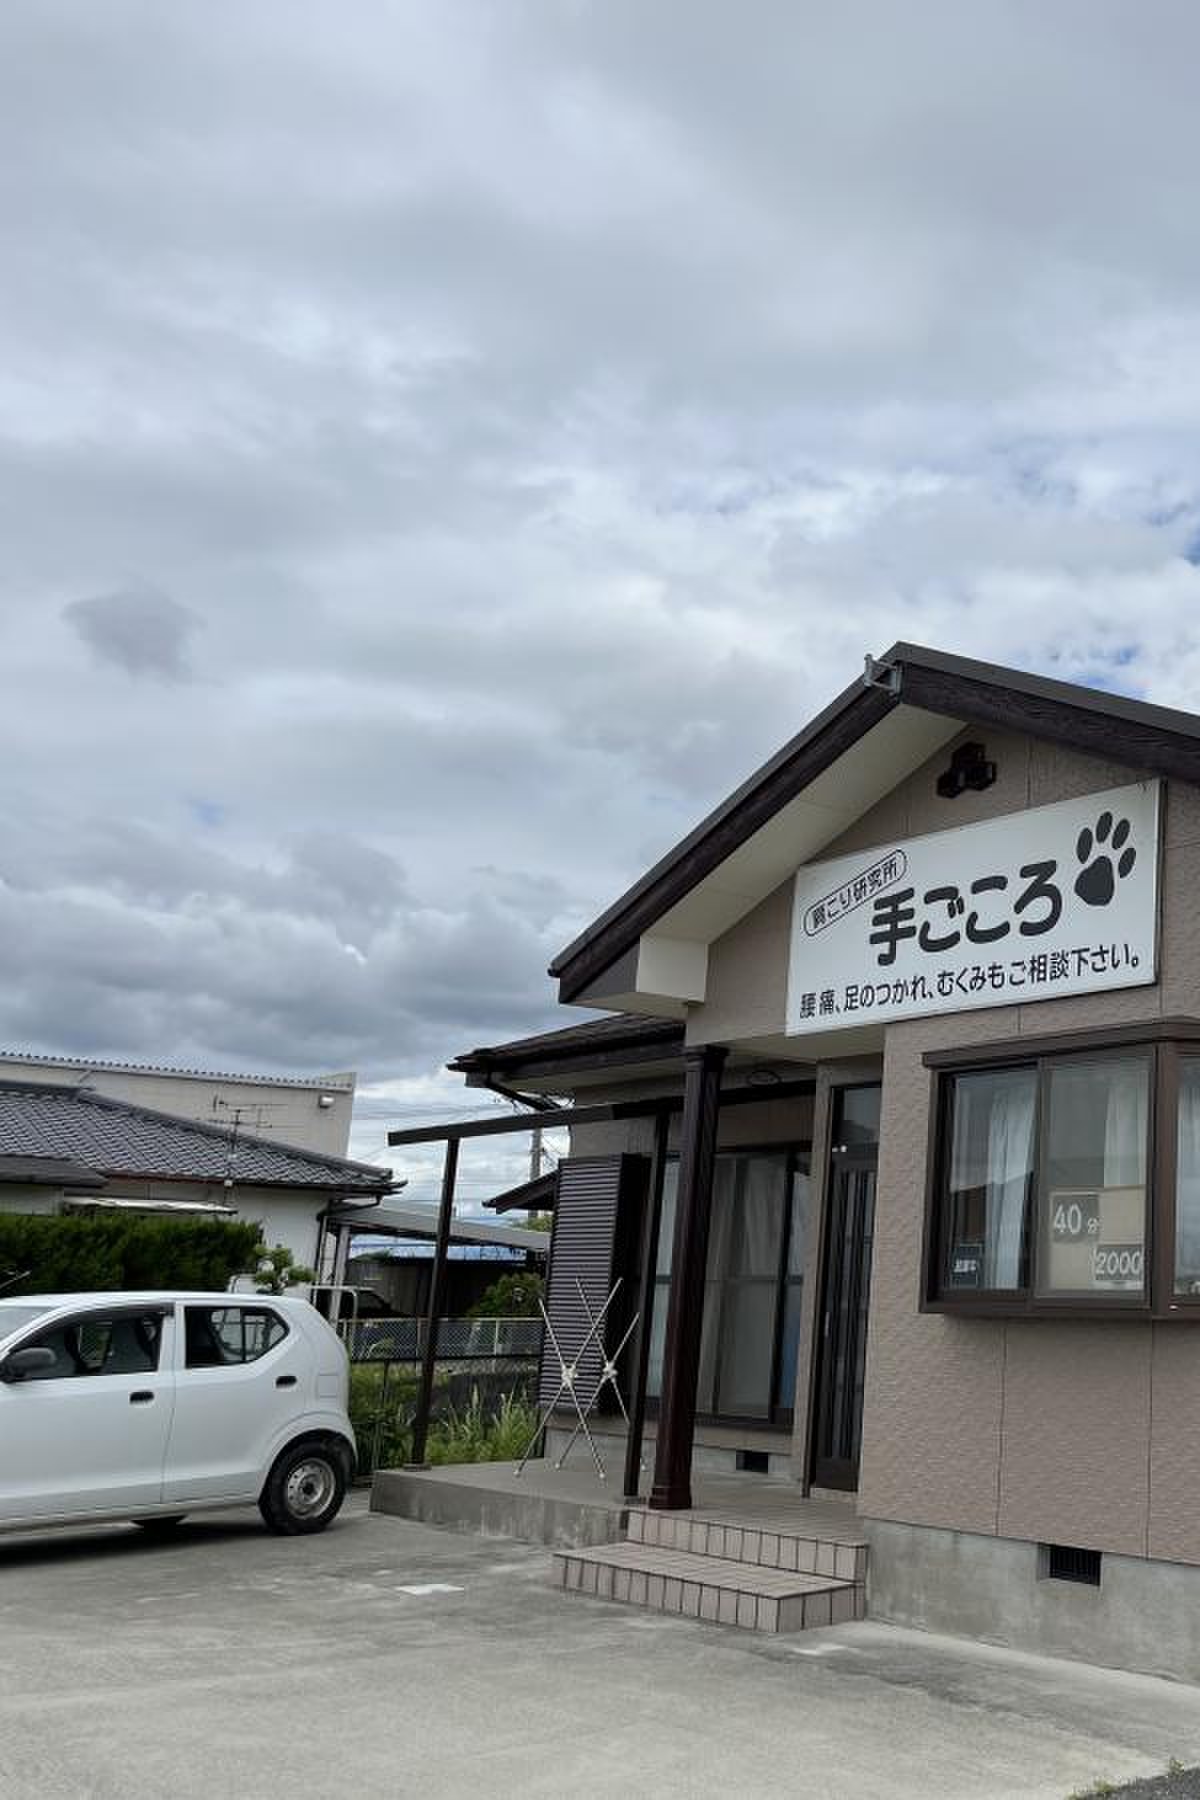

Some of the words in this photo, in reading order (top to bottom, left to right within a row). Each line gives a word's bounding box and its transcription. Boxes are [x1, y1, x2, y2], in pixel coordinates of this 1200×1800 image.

[868, 859, 1063, 966] 手ごころ
[799, 943, 1139, 1019] 腰痛、足のつかれ、むくみもご相談下さい。
